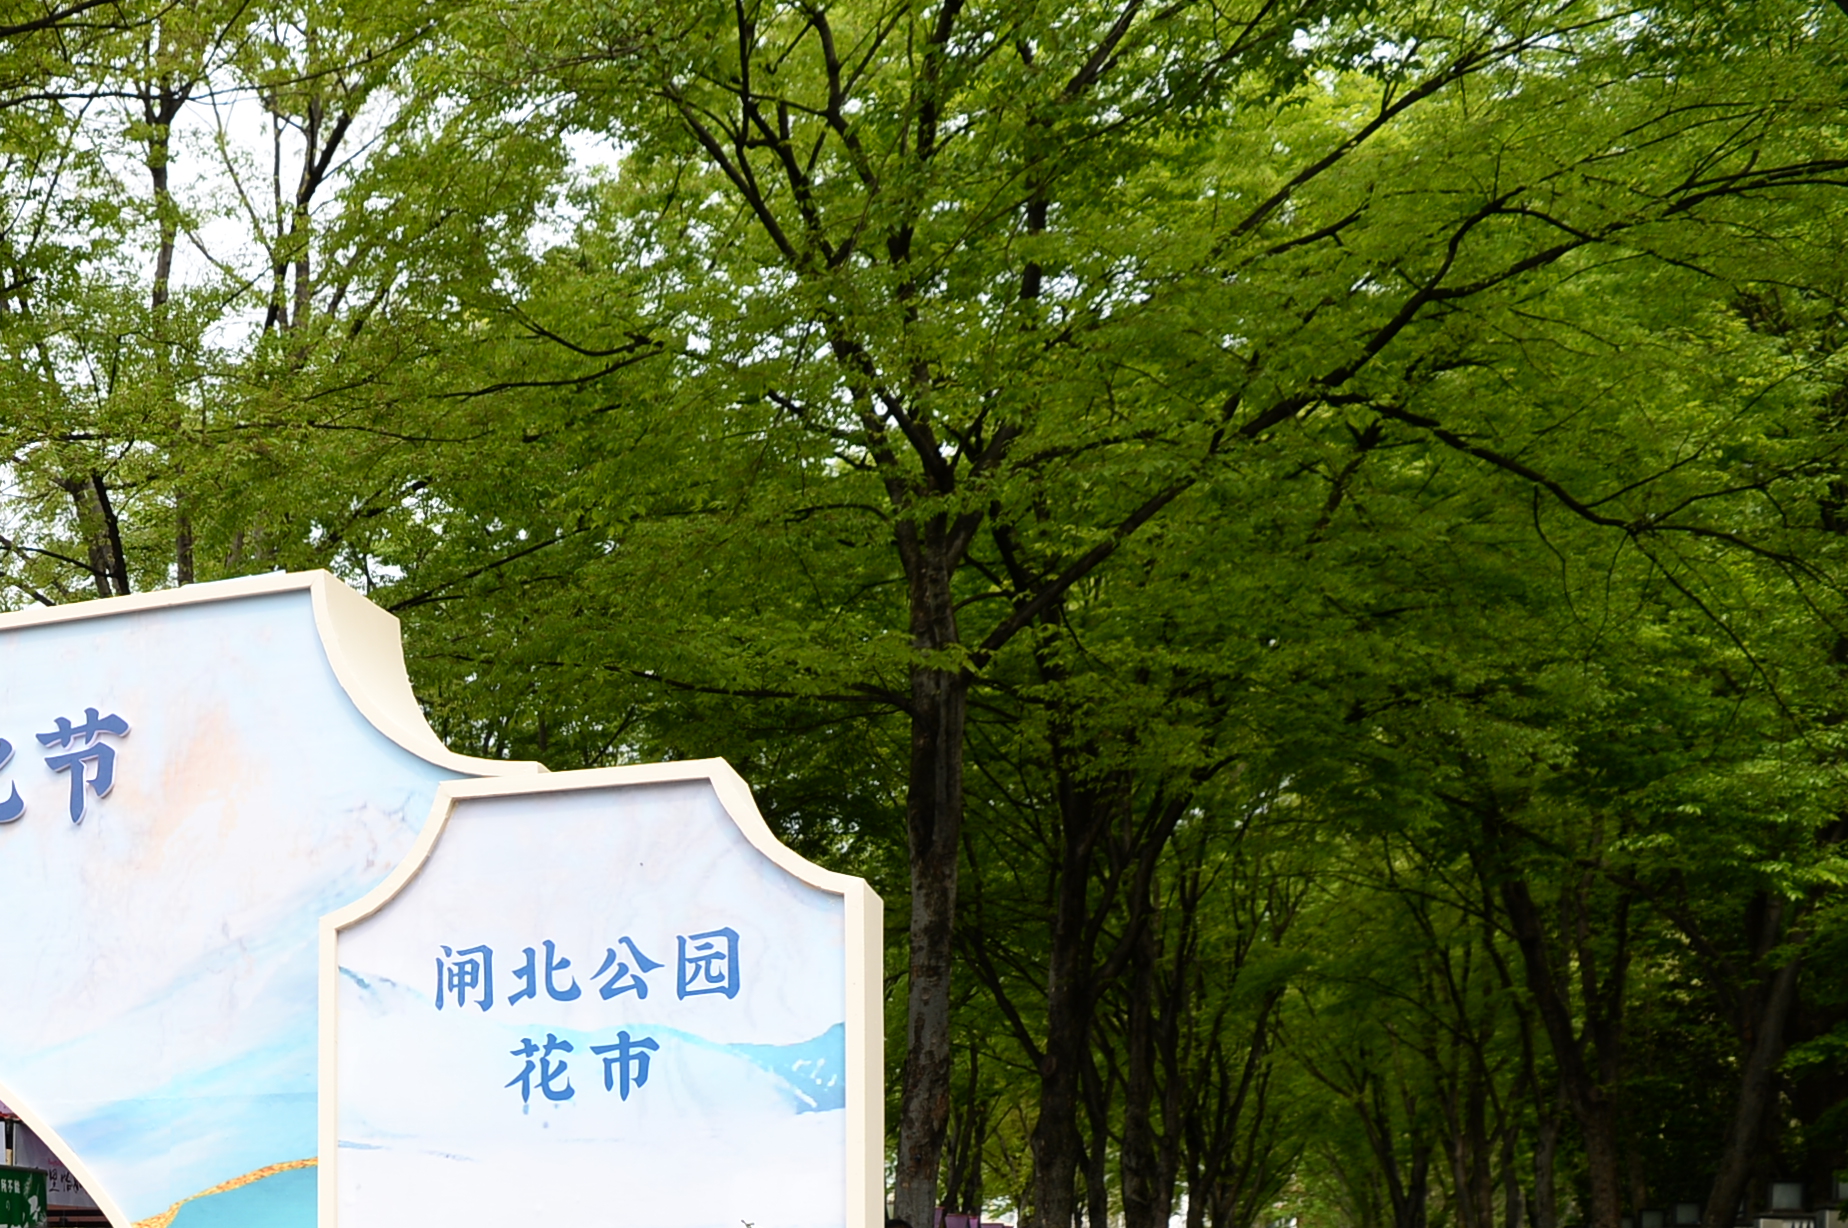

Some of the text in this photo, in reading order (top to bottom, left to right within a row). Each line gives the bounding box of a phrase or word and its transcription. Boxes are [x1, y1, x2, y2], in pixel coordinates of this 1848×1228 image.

[435, 927, 741, 1012] 闸北公园
[504, 1030, 660, 1103] 花市
